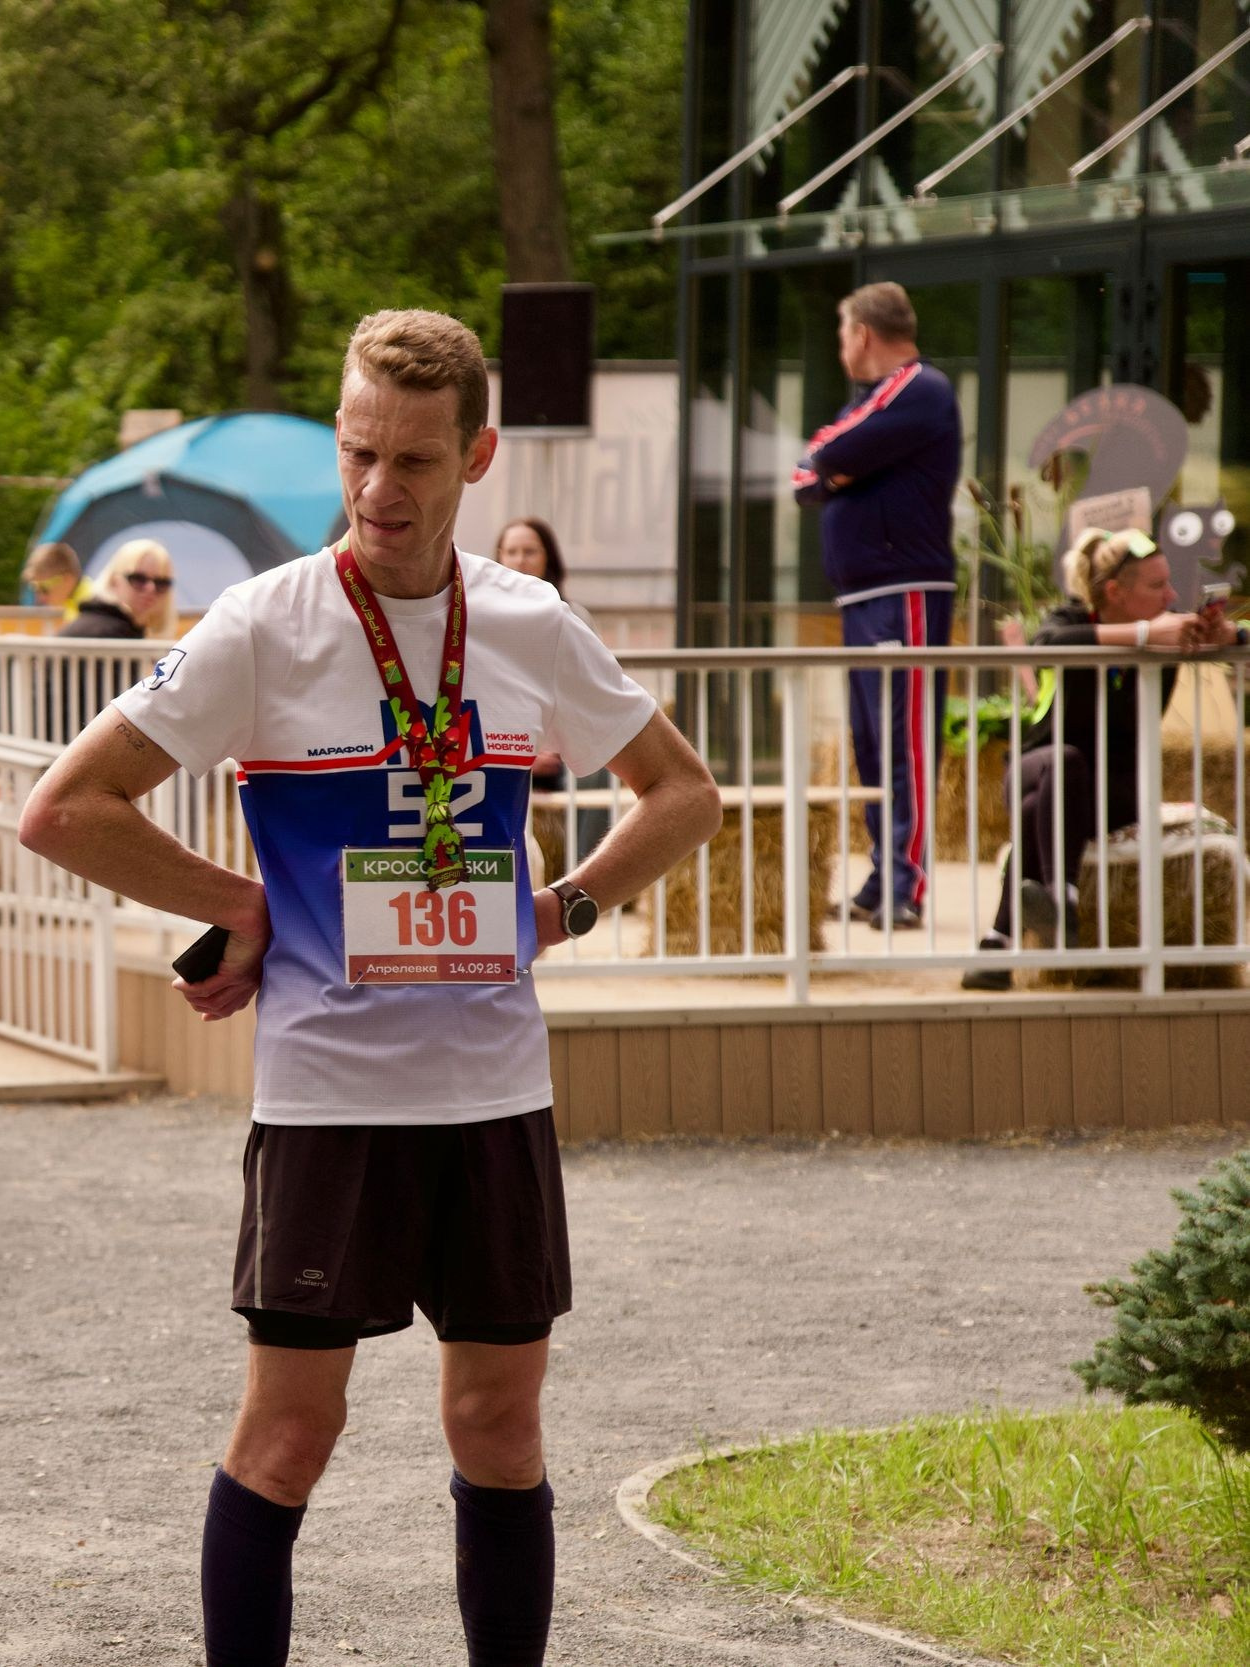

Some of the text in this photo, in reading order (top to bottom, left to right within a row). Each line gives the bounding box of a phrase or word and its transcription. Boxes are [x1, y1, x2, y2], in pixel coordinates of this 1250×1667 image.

[485, 732, 529, 742] НИЖНИЙ
[307, 744, 374, 757] МАРАФОН
[388, 771, 486, 838] 52
[389, 891, 477, 946] 136
[366, 963, 501, 975] Апрелевка 14.09.25
